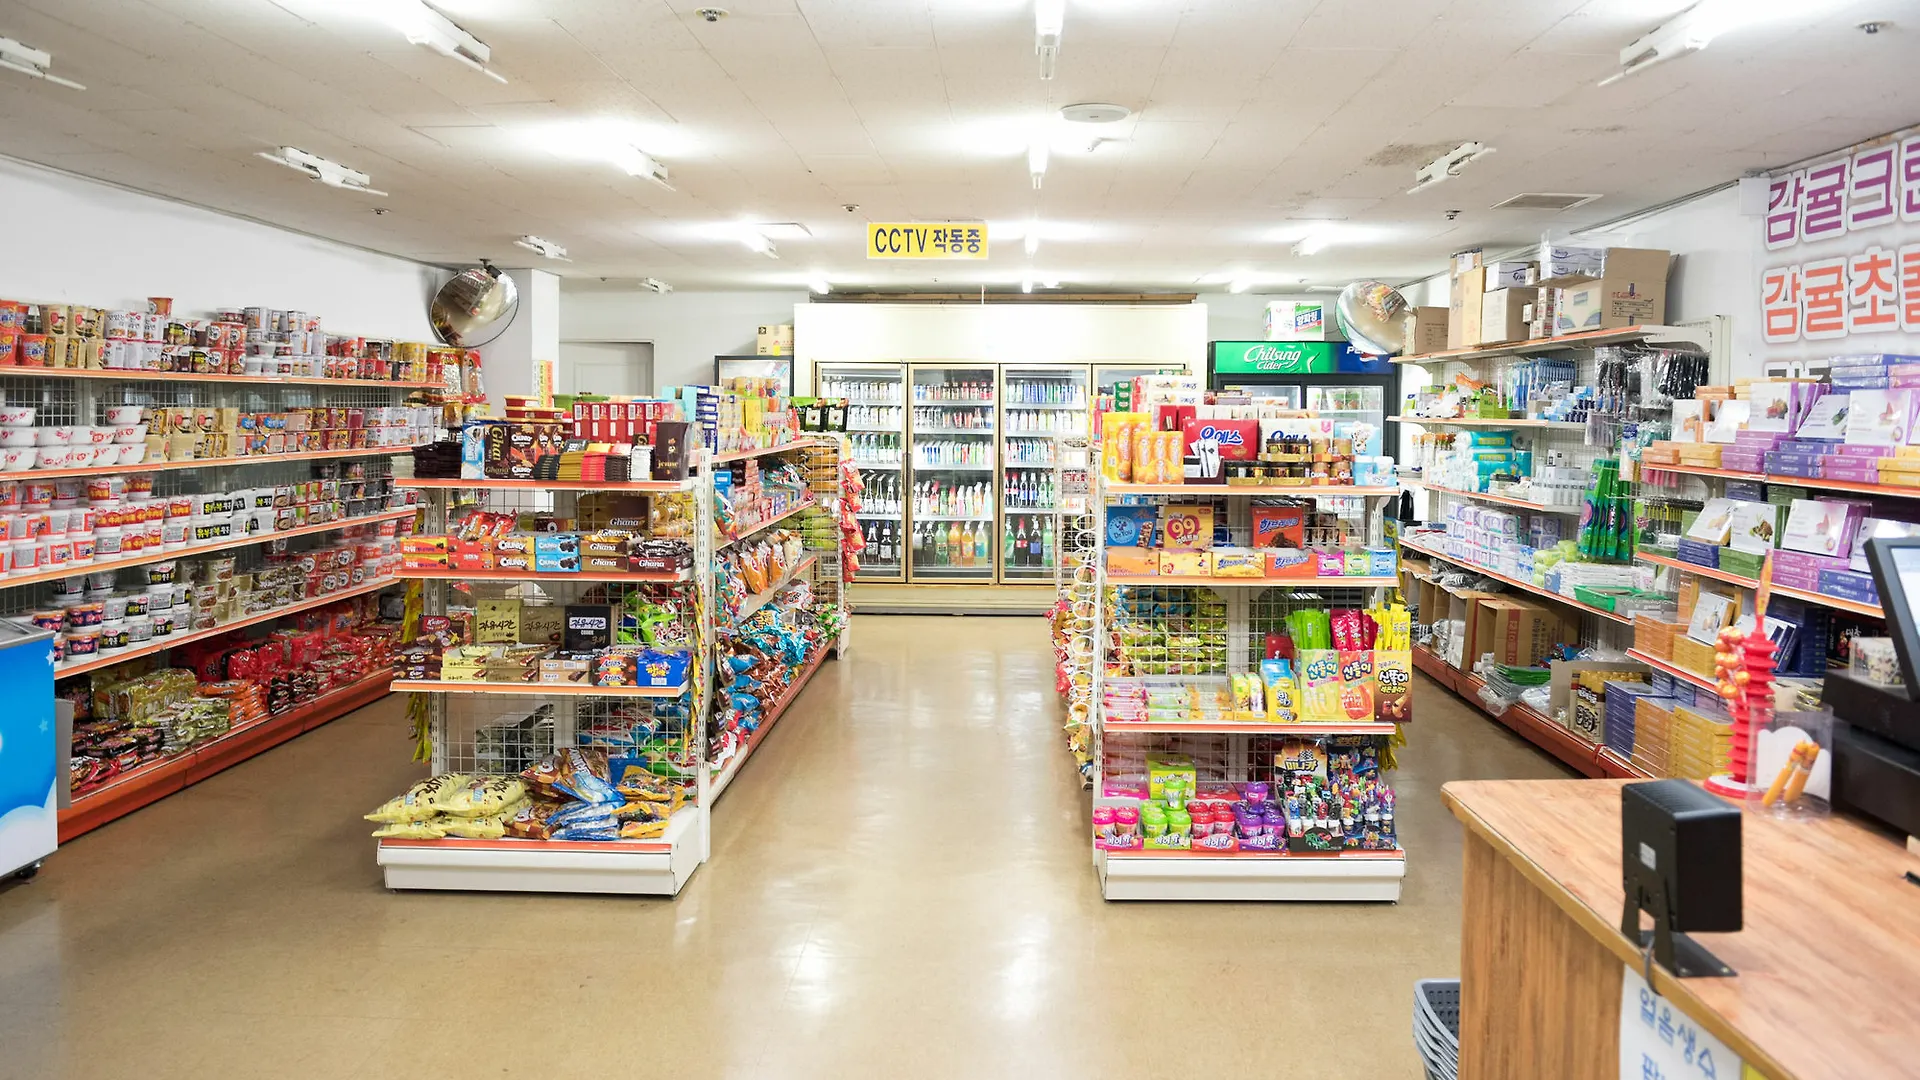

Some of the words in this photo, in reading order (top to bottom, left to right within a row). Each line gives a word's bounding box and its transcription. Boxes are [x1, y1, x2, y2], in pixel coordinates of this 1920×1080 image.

[875, 228, 927, 253] CCTV
[933, 228, 981, 253] 작동중
[1256, 360, 1283, 370] Cider
[1171, 518, 1196, 537] 99
[1259, 518, 1299, 534] 핫브레이크
[590, 543, 616, 551] Ghana
[591, 558, 617, 567] Ghana
[639, 560, 665, 568] Ghana
[479, 619, 517, 630] 자유시간
[570, 618, 605, 629] 자유시간
[1285, 760, 1318, 772] 미니카
